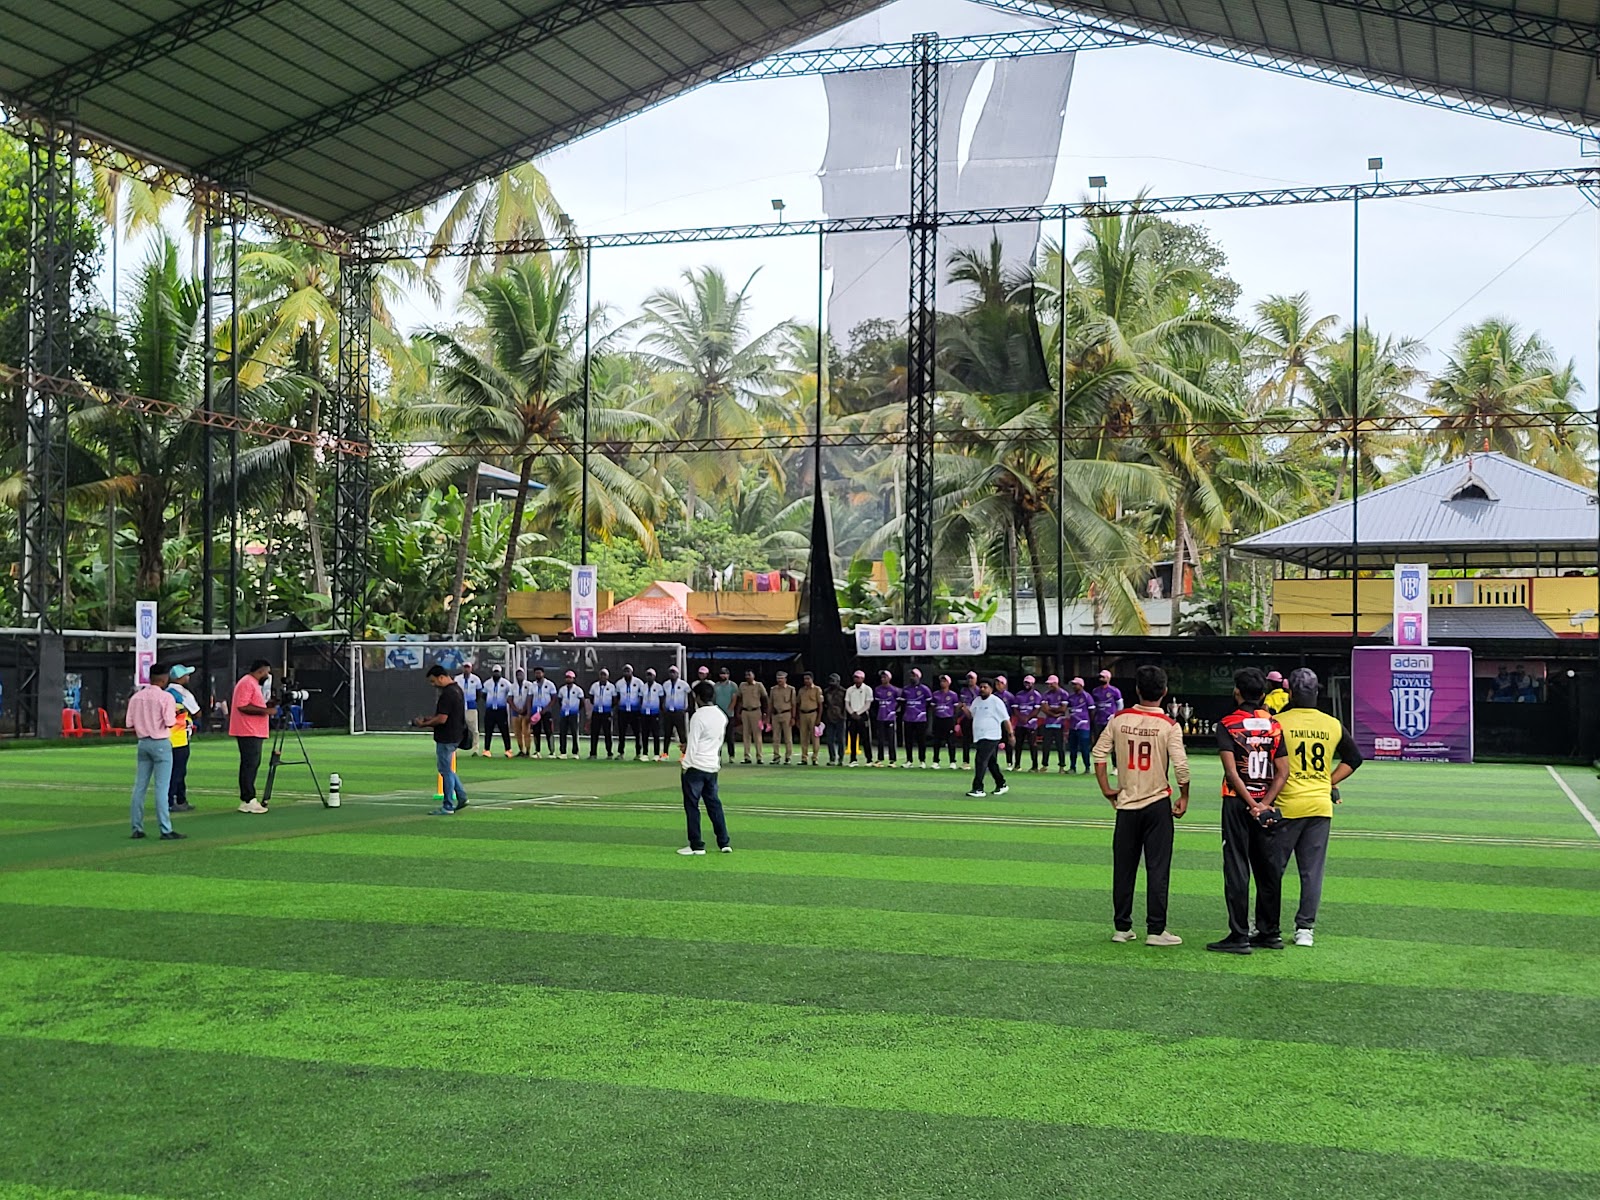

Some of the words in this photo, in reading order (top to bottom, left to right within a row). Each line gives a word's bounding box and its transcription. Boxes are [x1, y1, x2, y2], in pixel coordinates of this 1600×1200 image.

[1394, 657, 1430, 668] adani
[1393, 679, 1431, 688] ROYALS
[1120, 725, 1160, 737] GILCHRIST
[1290, 729, 1330, 741] TAMILNADU
[1127, 739, 1152, 771] 18
[1294, 741, 1326, 772] 18
[1248, 751, 1269, 780] 07
